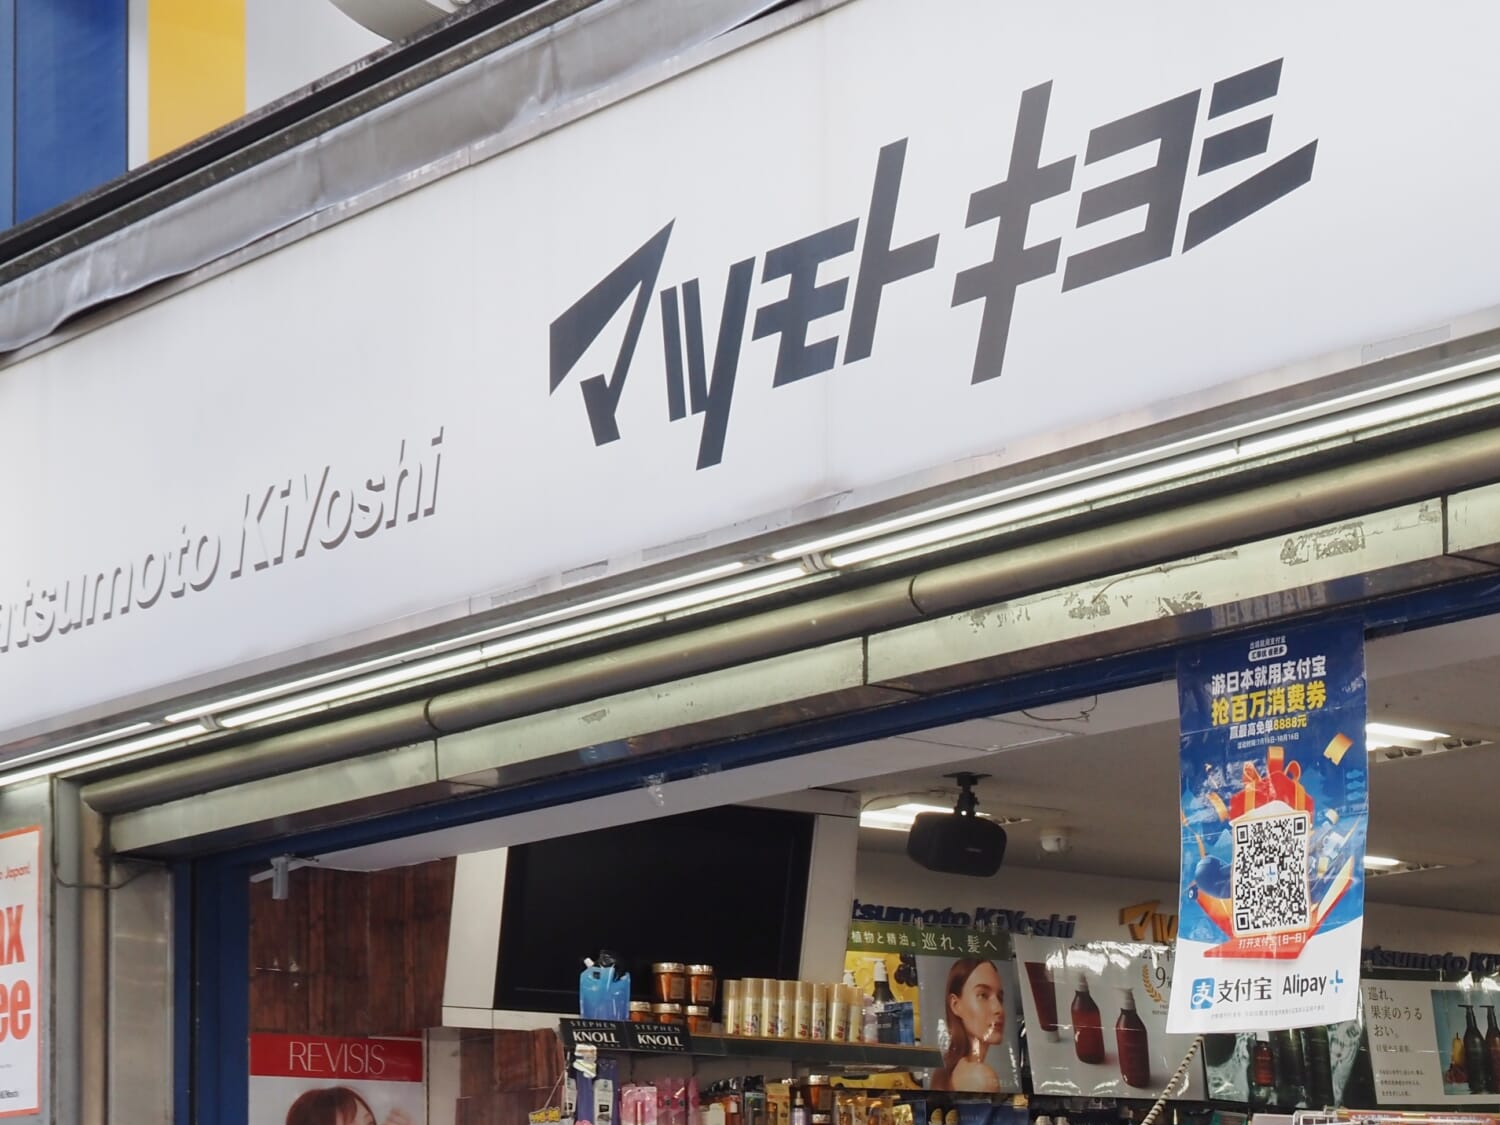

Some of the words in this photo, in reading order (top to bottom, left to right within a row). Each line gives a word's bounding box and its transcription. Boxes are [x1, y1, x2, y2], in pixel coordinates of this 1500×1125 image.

[550, 57, 1319, 471] マツモトキヨシ
[228, 426, 445, 583] KiYoshi
[1211, 655, 1327, 696] 游日本就用支付宝
[1211, 680, 1327, 727] 抢百万消费券
[1216, 976, 1272, 1004] 支付宝
[1282, 974, 1327, 997] Alipay
[571, 1020, 617, 1029] STEPHEN
[635, 1023, 681, 1033] STEPHEN
[1370, 1004, 1423, 1022] 果実のうる
[573, 1031, 621, 1044] KNOLL
[637, 1034, 684, 1047] KNOLL
[289, 1040, 386, 1076] REVISIS
